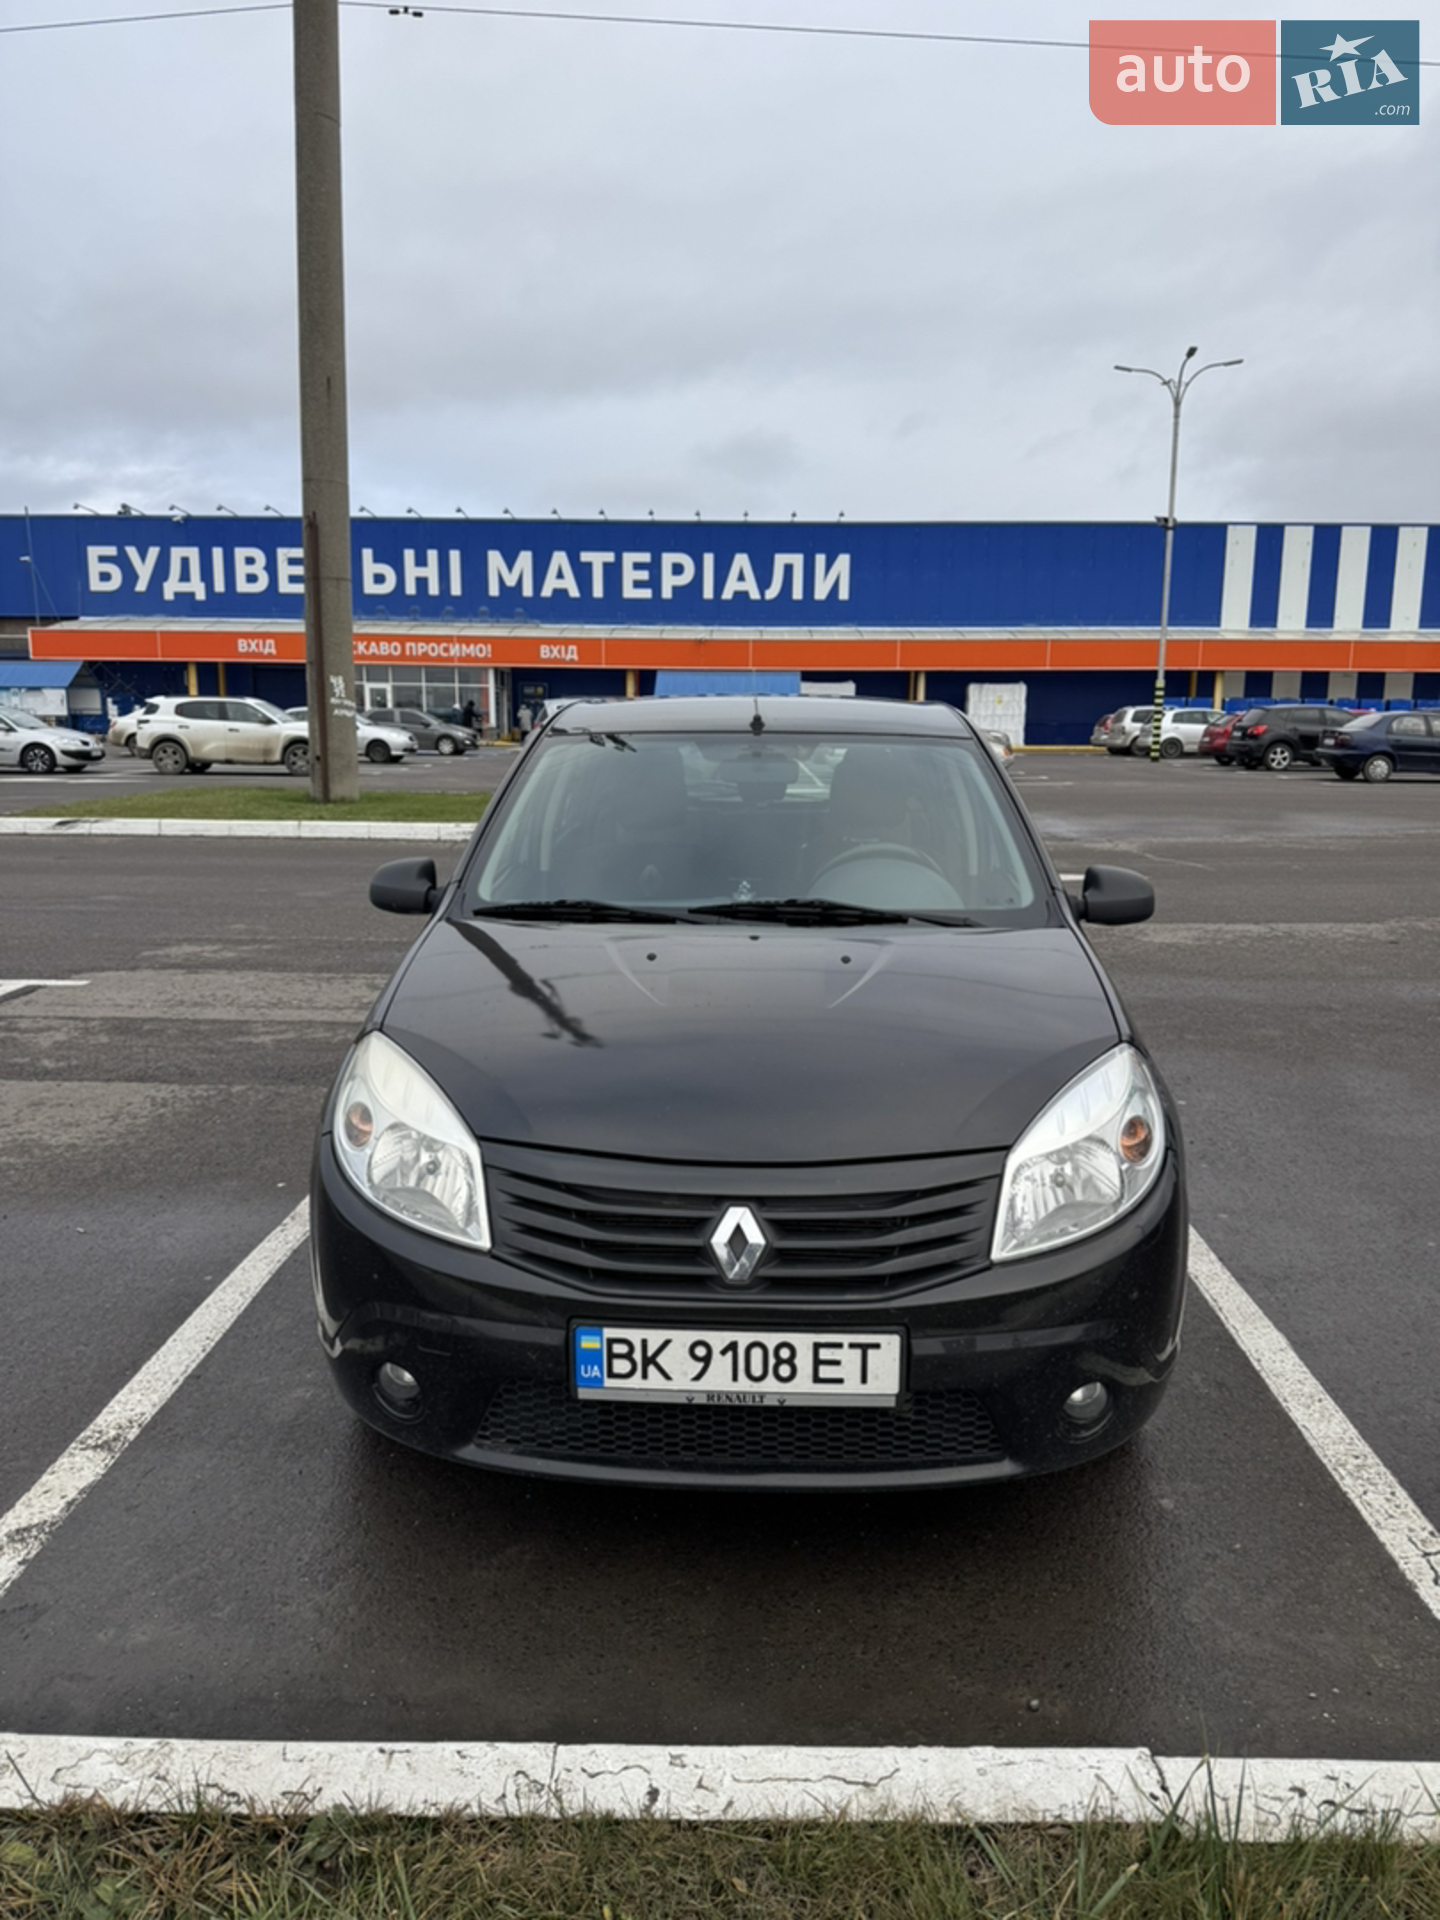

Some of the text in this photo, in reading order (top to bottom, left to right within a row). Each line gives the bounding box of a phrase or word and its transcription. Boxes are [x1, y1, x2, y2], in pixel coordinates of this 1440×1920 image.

[86, 545, 852, 601] БУДІВЕЬНІ МАТЕРІАЛИ
[237, 638, 276, 655] ВХІД
[405, 641, 492, 659] ПРОСИМО!
[539, 644, 579, 661] ВХІД
[606, 1337, 881, 1385] BK 9108 ET
[580, 1364, 601, 1379] UA
[706, 1393, 766, 1404] RENAULT
